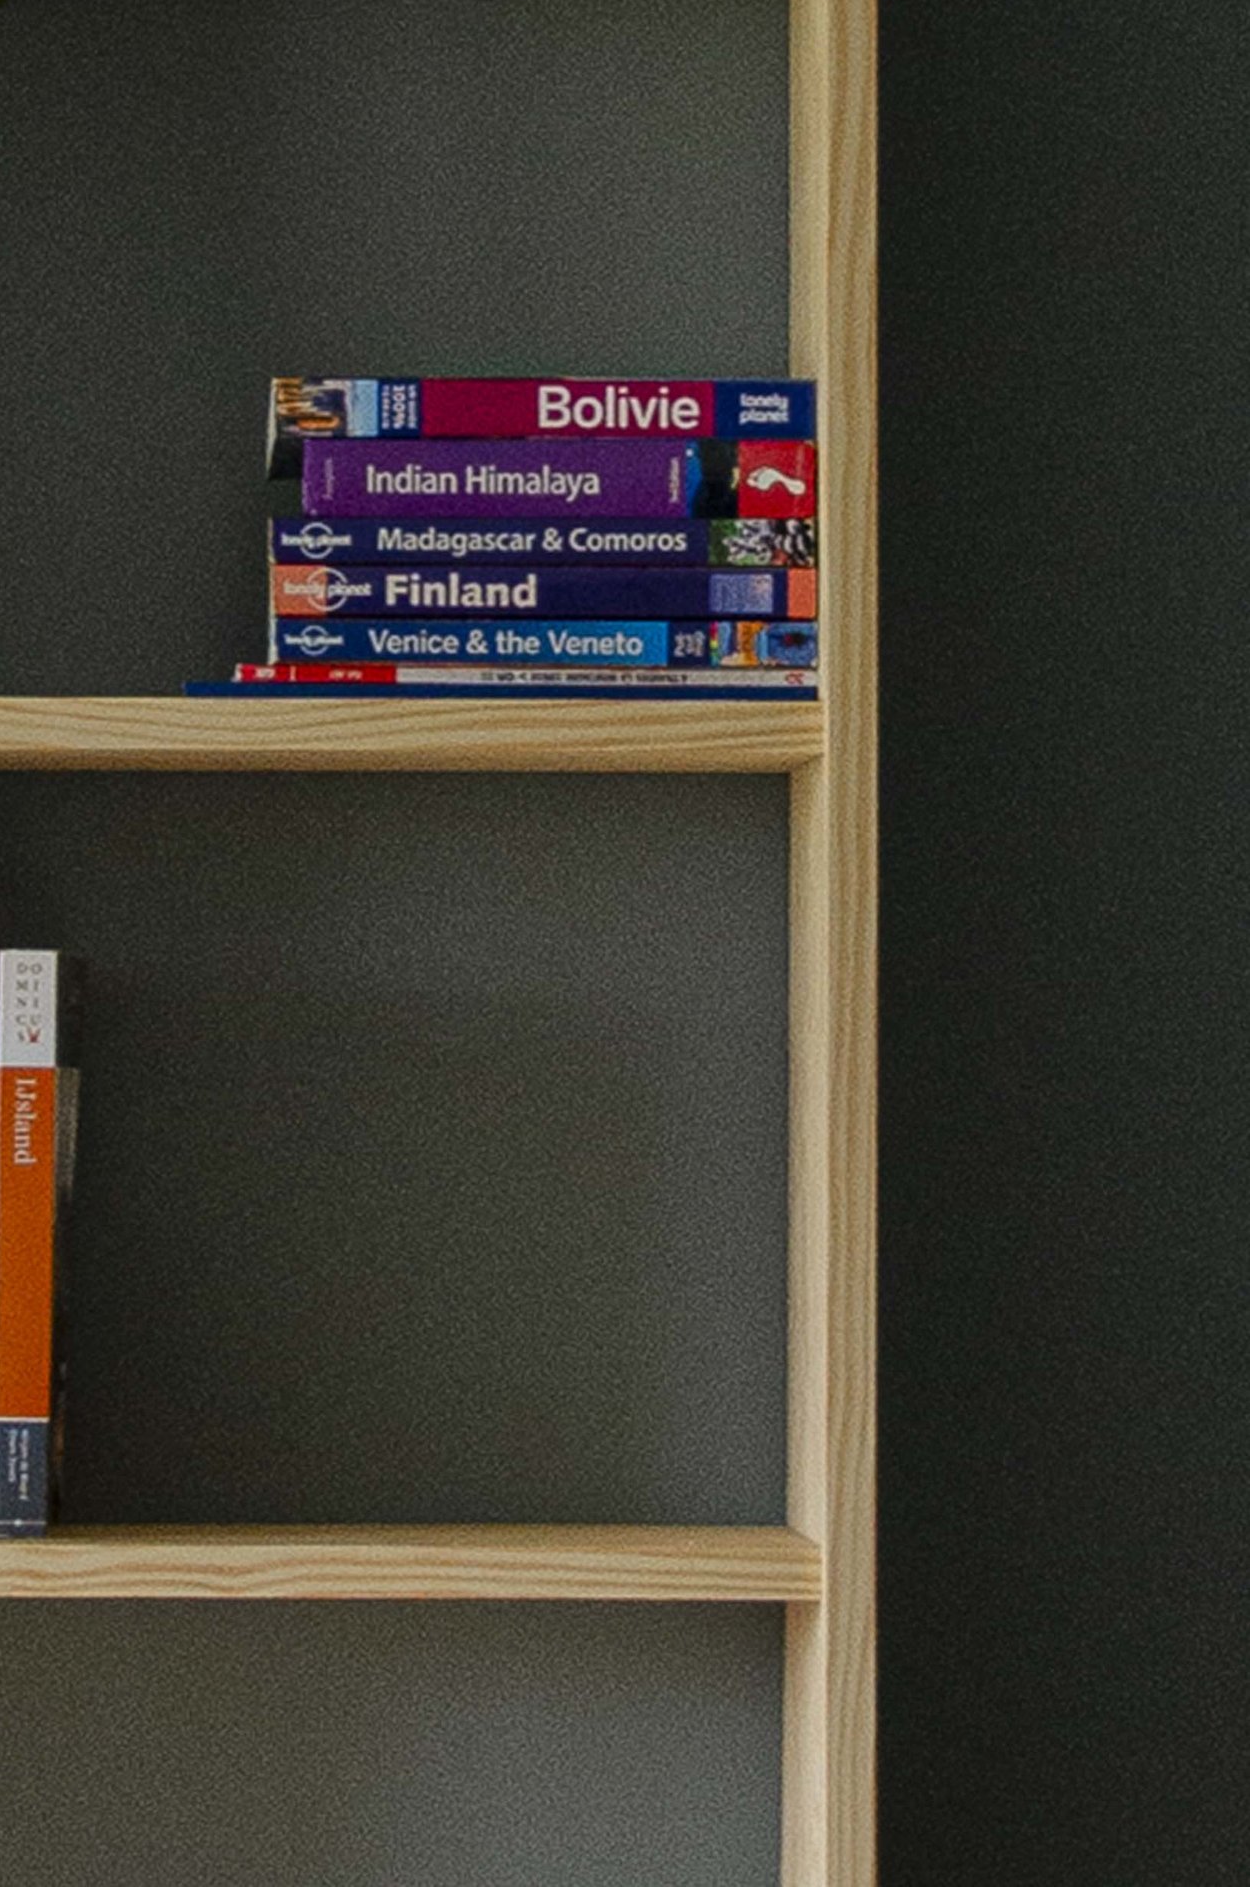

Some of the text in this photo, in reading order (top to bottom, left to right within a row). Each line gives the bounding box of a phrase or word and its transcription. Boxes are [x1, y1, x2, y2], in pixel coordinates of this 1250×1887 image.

[537, 384, 701, 430] Bolivie
[738, 409, 790, 426] planet
[739, 392, 790, 410] lonely
[365, 463, 459, 495] Indian
[464, 463, 601, 502] Himalaya
[376, 526, 688, 557] Madagascar & Comoros
[385, 572, 538, 607] Finland
[367, 628, 460, 655] Venice
[465, 628, 489, 655] &
[495, 630, 540, 656] the
[548, 629, 643, 656] Veneto
[13, 1077, 38, 1164] IJsland
